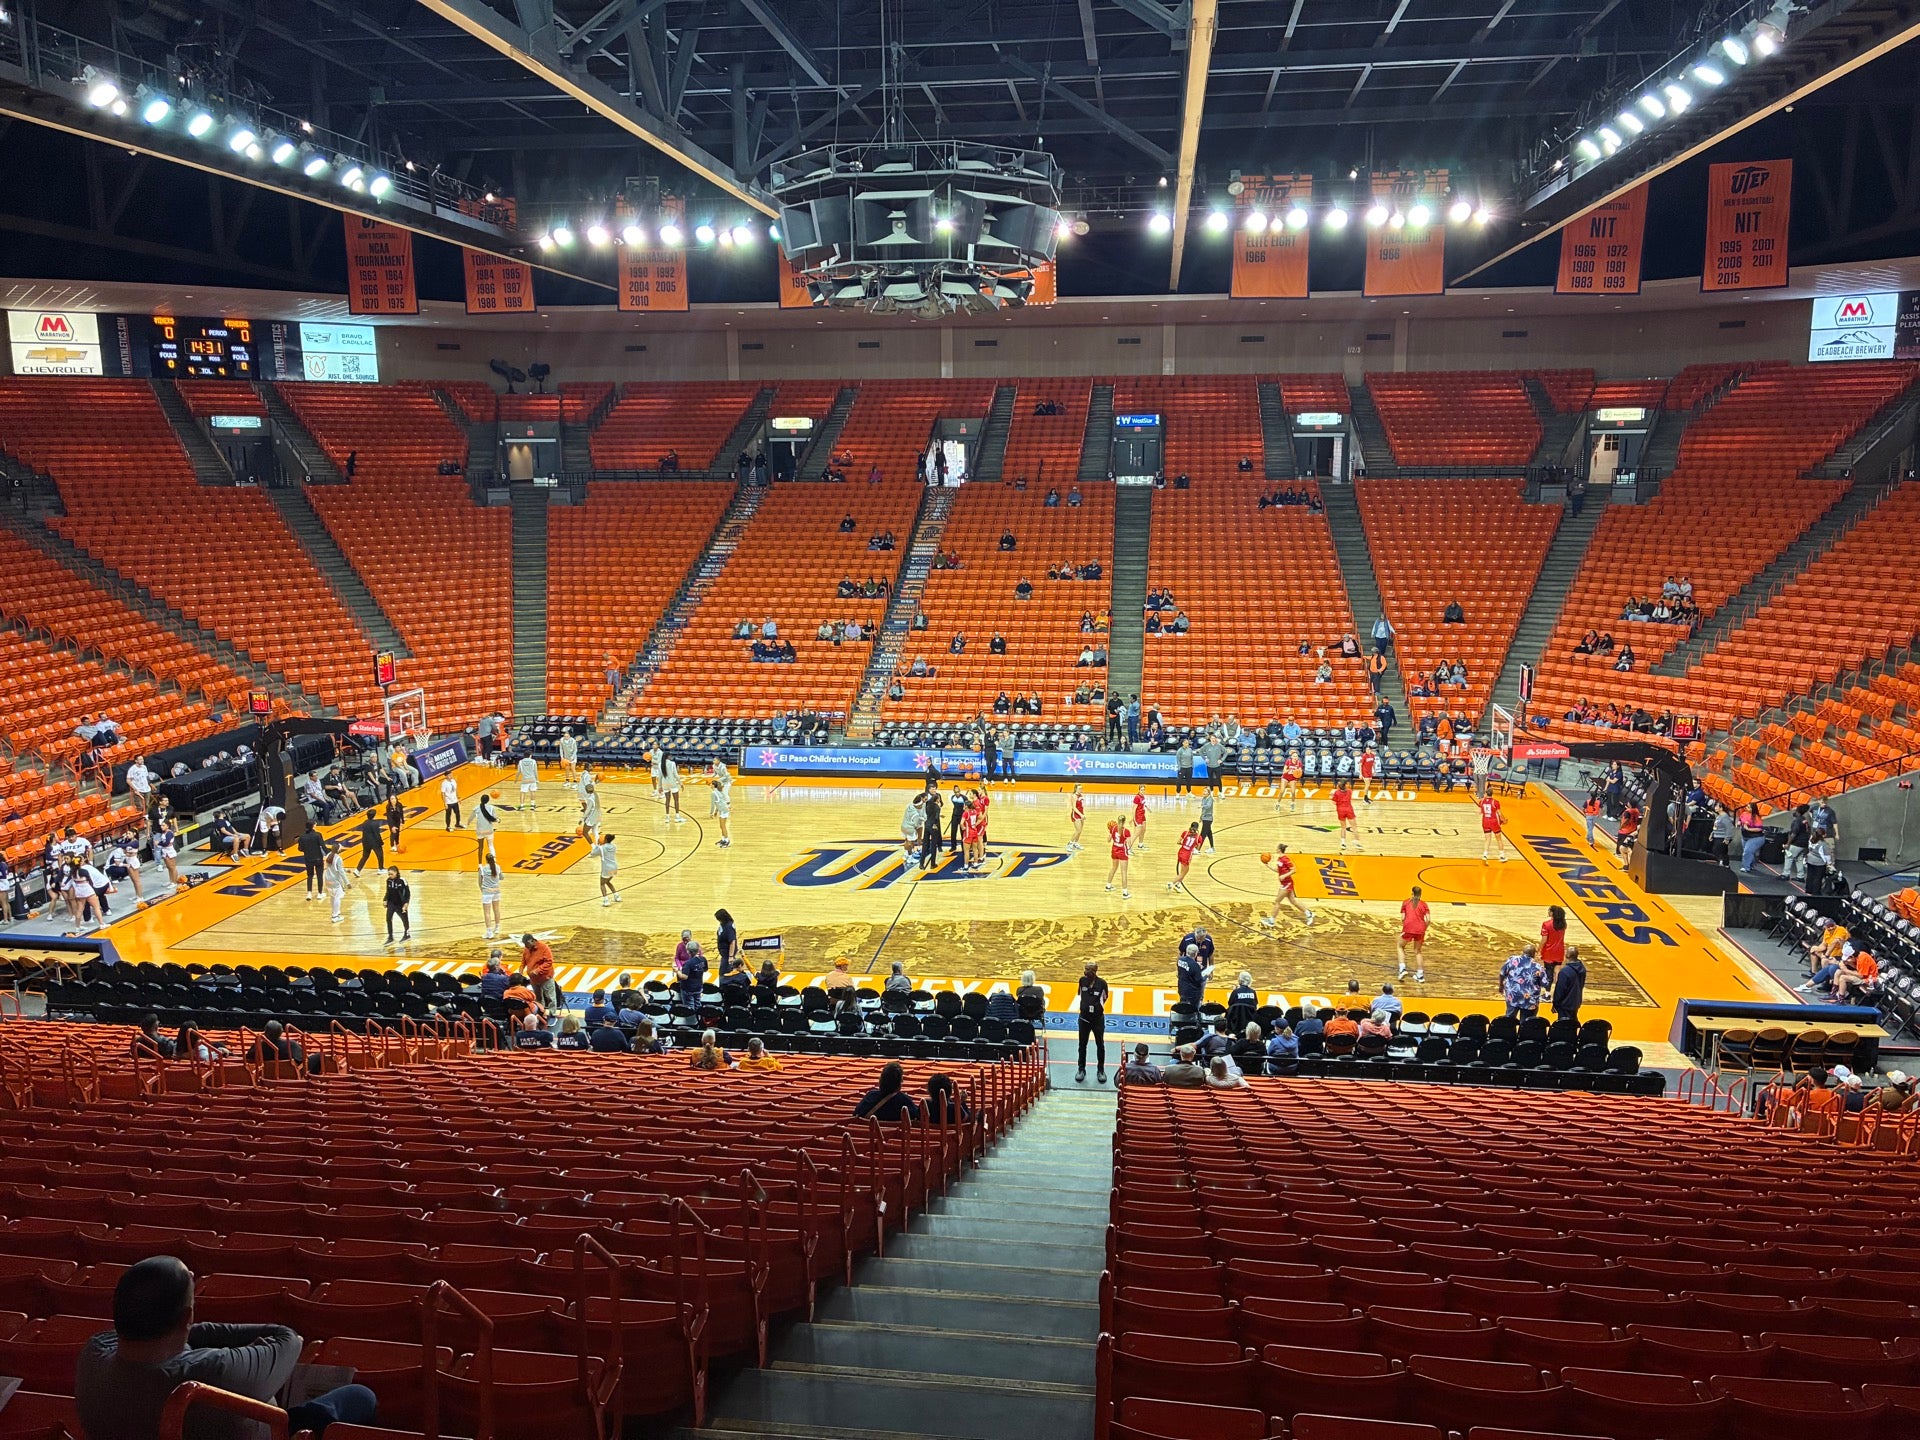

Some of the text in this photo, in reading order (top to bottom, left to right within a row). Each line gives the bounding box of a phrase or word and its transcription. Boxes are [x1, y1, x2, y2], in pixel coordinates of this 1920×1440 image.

[1731, 166, 1770, 194] UTEP
[1590, 217, 1617, 238] NIT
[1735, 211, 1761, 233] NIT
[1246, 235, 1296, 247] ELITE EIGHT
[1720, 239, 1775, 254] 1995 2001
[369, 243, 390, 253] NCAA
[1607, 245, 1628, 257] 1972
[1246, 252, 1266, 263] 1966
[1379, 249, 1400, 260] 1966
[355, 255, 405, 267] TOURNAMENT
[1717, 255, 1773, 269] 2006 2011
[630, 267, 675, 278] 1990 1992
[1573, 261, 1626, 273] 1980 1981
[360, 270, 403, 280] 1963 1964
[476, 268, 520, 280] 1984 1985
[1717, 272, 1740, 285] 2015
[629, 281, 676, 292] 2004 2005
[1571, 276, 1625, 288] 1983 1993
[361, 284, 403, 294] 1966 1967
[477, 283, 521, 294] 1986 1987
[362, 298, 405, 309] 1970 1975
[478, 297, 522, 308] 1988 1989
[630, 296, 649, 306] 2010
[164, 326, 174, 339] 0
[241, 330, 250, 341] 0
[117, 317, 132, 375] UTEPATHLETICS.COM
[191, 341, 222, 353] 14:31
[1817, 345, 1854, 356] DEADBEACH
[1855, 344, 1887, 354] BREWERY
[168, 360, 175, 368] 0
[241, 362, 248, 370] 0
[22, 366, 95, 374] CHEVROLET
[188, 366, 195, 374] 4
[218, 367, 225, 375] 4
[1678, 726, 1691, 735] 30
[434, 748, 455, 761] MINER
[779, 754, 881, 765] El Paso Children's Hospital
[1085, 760, 1093, 768] El
[1095, 761, 1114, 769] Paso
[1116, 761, 1156, 769] Children's
[1220, 786, 1321, 799] GLORY
[1483, 804, 1492, 814] 13
[1346, 826, 1460, 837] GECU
[1521, 834, 1680, 947] MINERS
